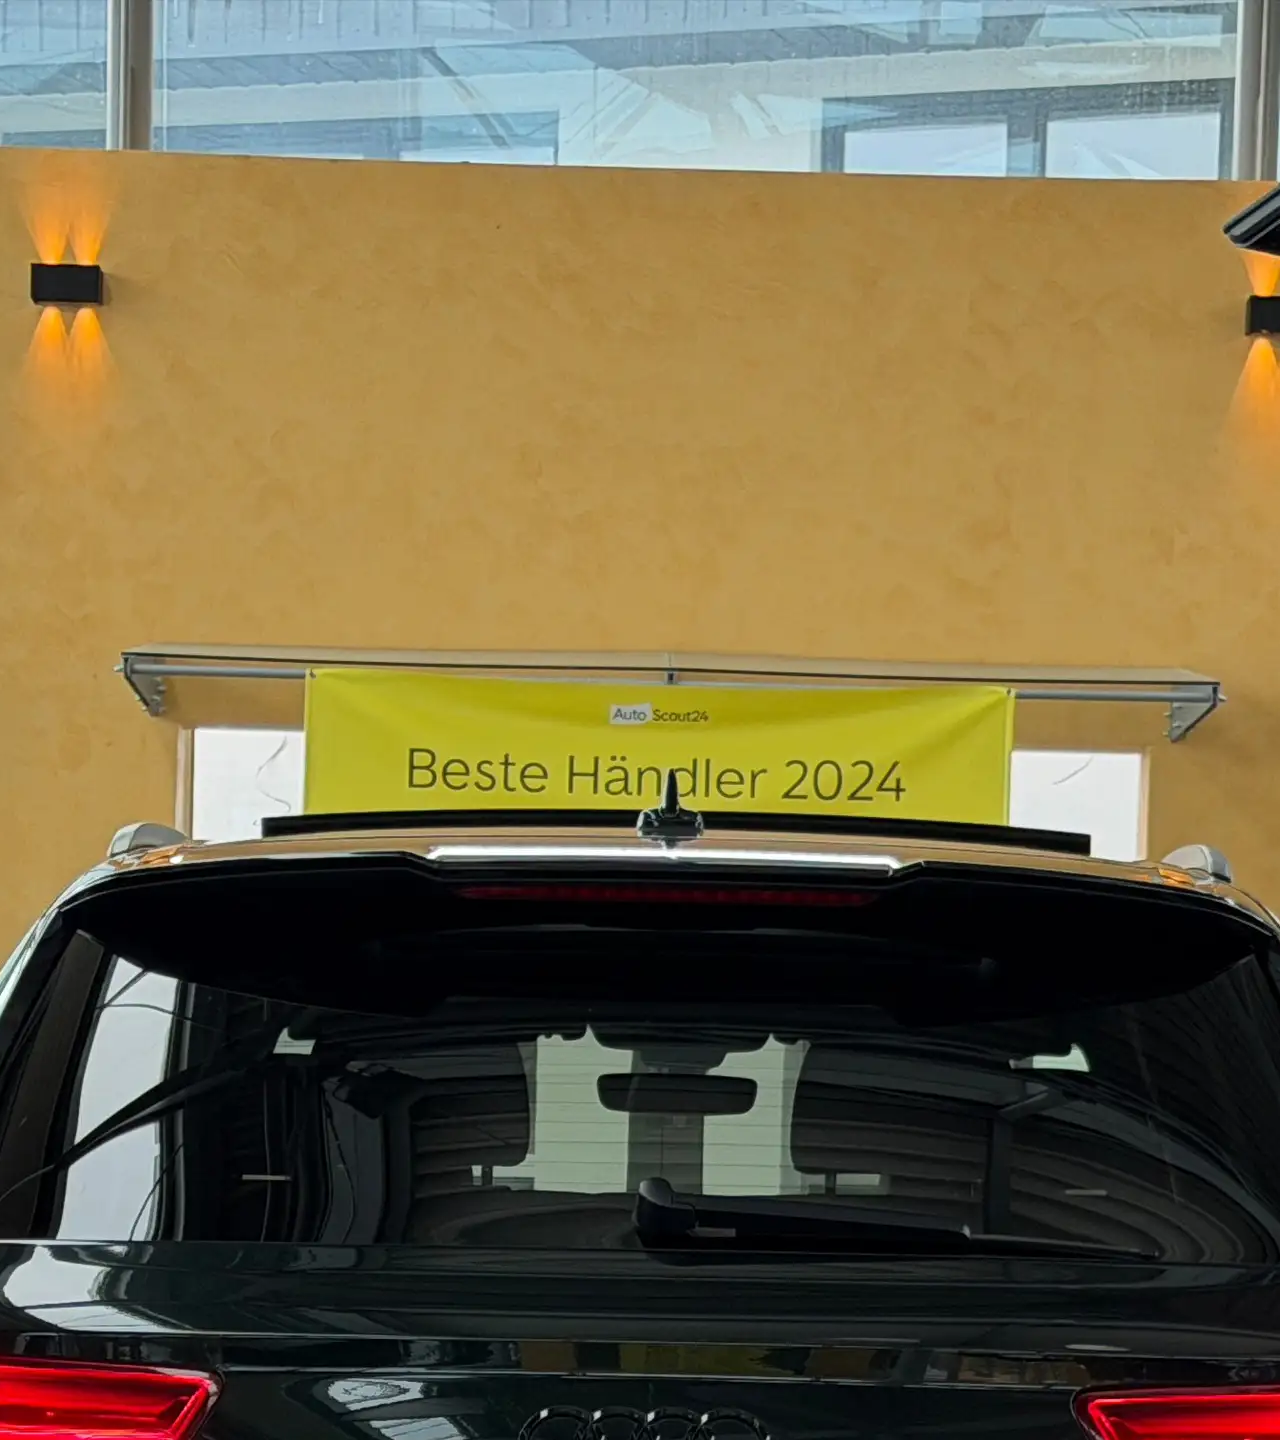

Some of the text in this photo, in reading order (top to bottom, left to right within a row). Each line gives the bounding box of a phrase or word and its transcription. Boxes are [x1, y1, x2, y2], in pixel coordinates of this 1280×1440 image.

[612, 707, 709, 724] Auto Scout24
[406, 747, 908, 803] Beste Händler 2024
